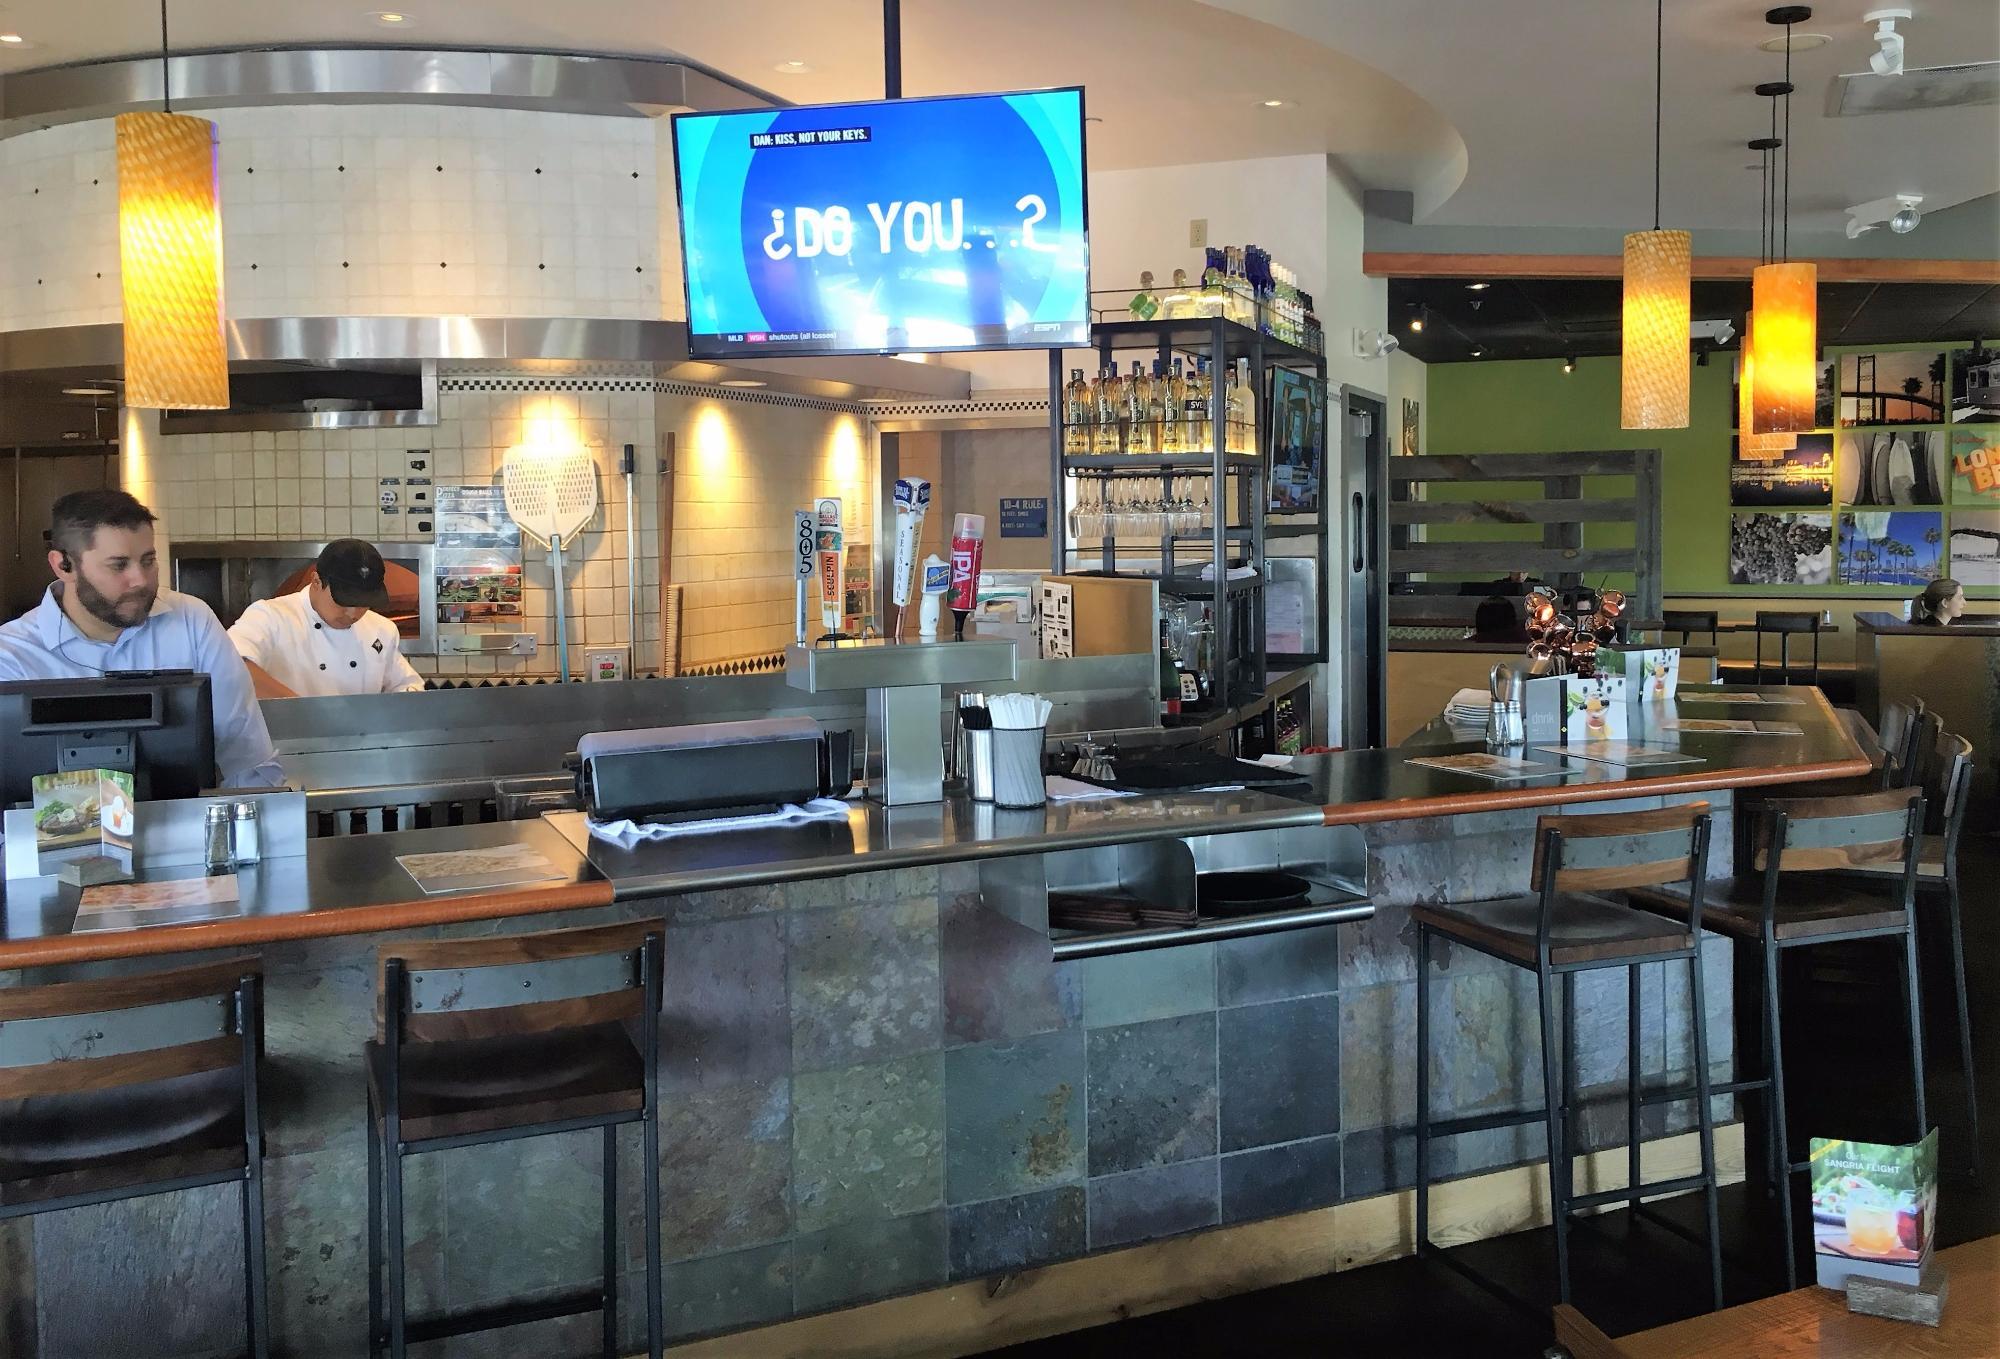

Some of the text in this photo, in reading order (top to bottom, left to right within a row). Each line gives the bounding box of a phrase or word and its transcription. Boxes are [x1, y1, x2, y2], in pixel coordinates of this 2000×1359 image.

[753, 129, 868, 146] DAN: KISS, NOT YOUR KEYS.
[768, 333, 799, 341] shutouts
[799, 519, 813, 574] 805
[825, 556, 835, 597] SCULPIN
[896, 530, 905, 599] SEASONAL
[953, 551, 972, 582] IPA
[1824, 1158, 1864, 1170] SANGRIA
[1866, 1163, 1901, 1174] FLIGHT
